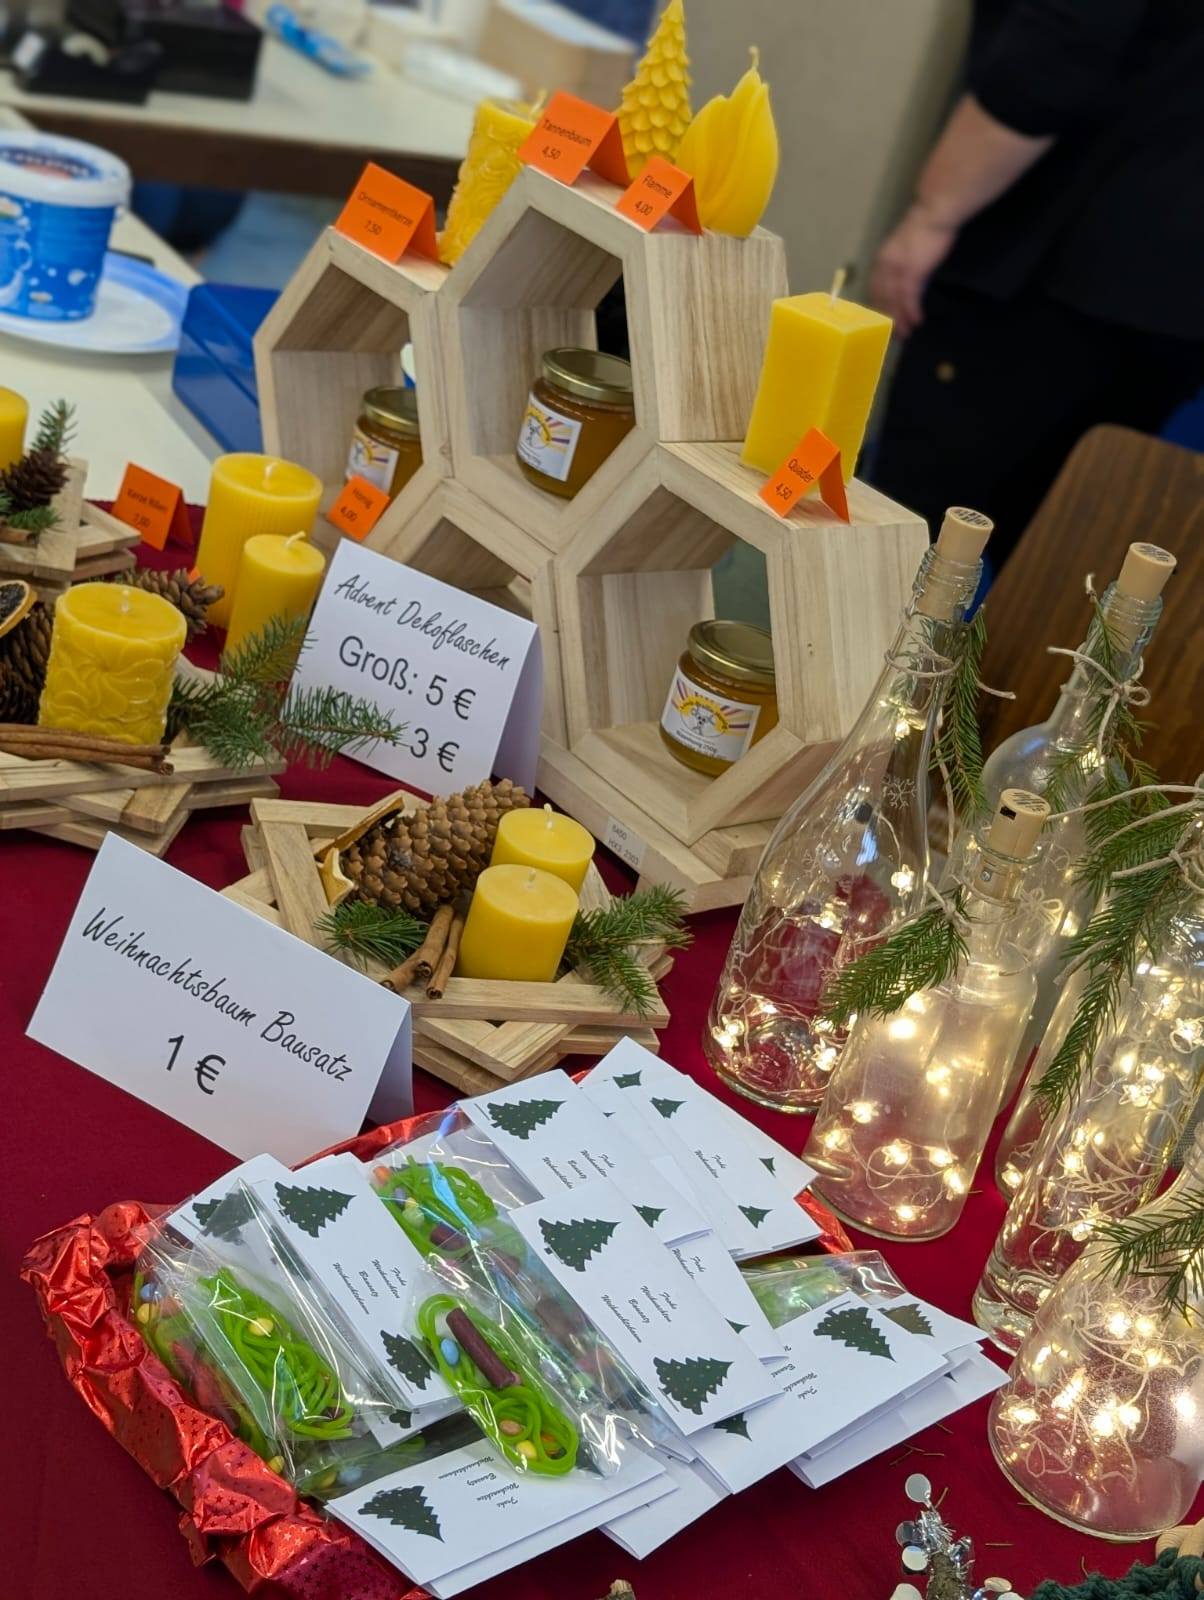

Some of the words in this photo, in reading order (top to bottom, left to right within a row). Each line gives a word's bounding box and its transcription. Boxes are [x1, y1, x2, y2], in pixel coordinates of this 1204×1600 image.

[543, 119, 592, 147] Tannenbaum
[642, 175, 673, 199] Flamme
[775, 483, 793, 500] 4,50
[787, 458, 815, 484] Quader
[334, 574, 397, 616] Advent
[396, 600, 510, 671] Dekoflaschen
[338, 635, 419, 695] Groß:
[425, 674, 448, 706] 5
[452, 688, 477, 721] €
[409, 727, 430, 759] 3
[436, 741, 460, 773] €
[82, 906, 257, 1028] Weihnachtsbaum
[260, 1010, 353, 1082] Bausatz
[166, 1034, 185, 1072] 1
[194, 1054, 227, 1095] €
